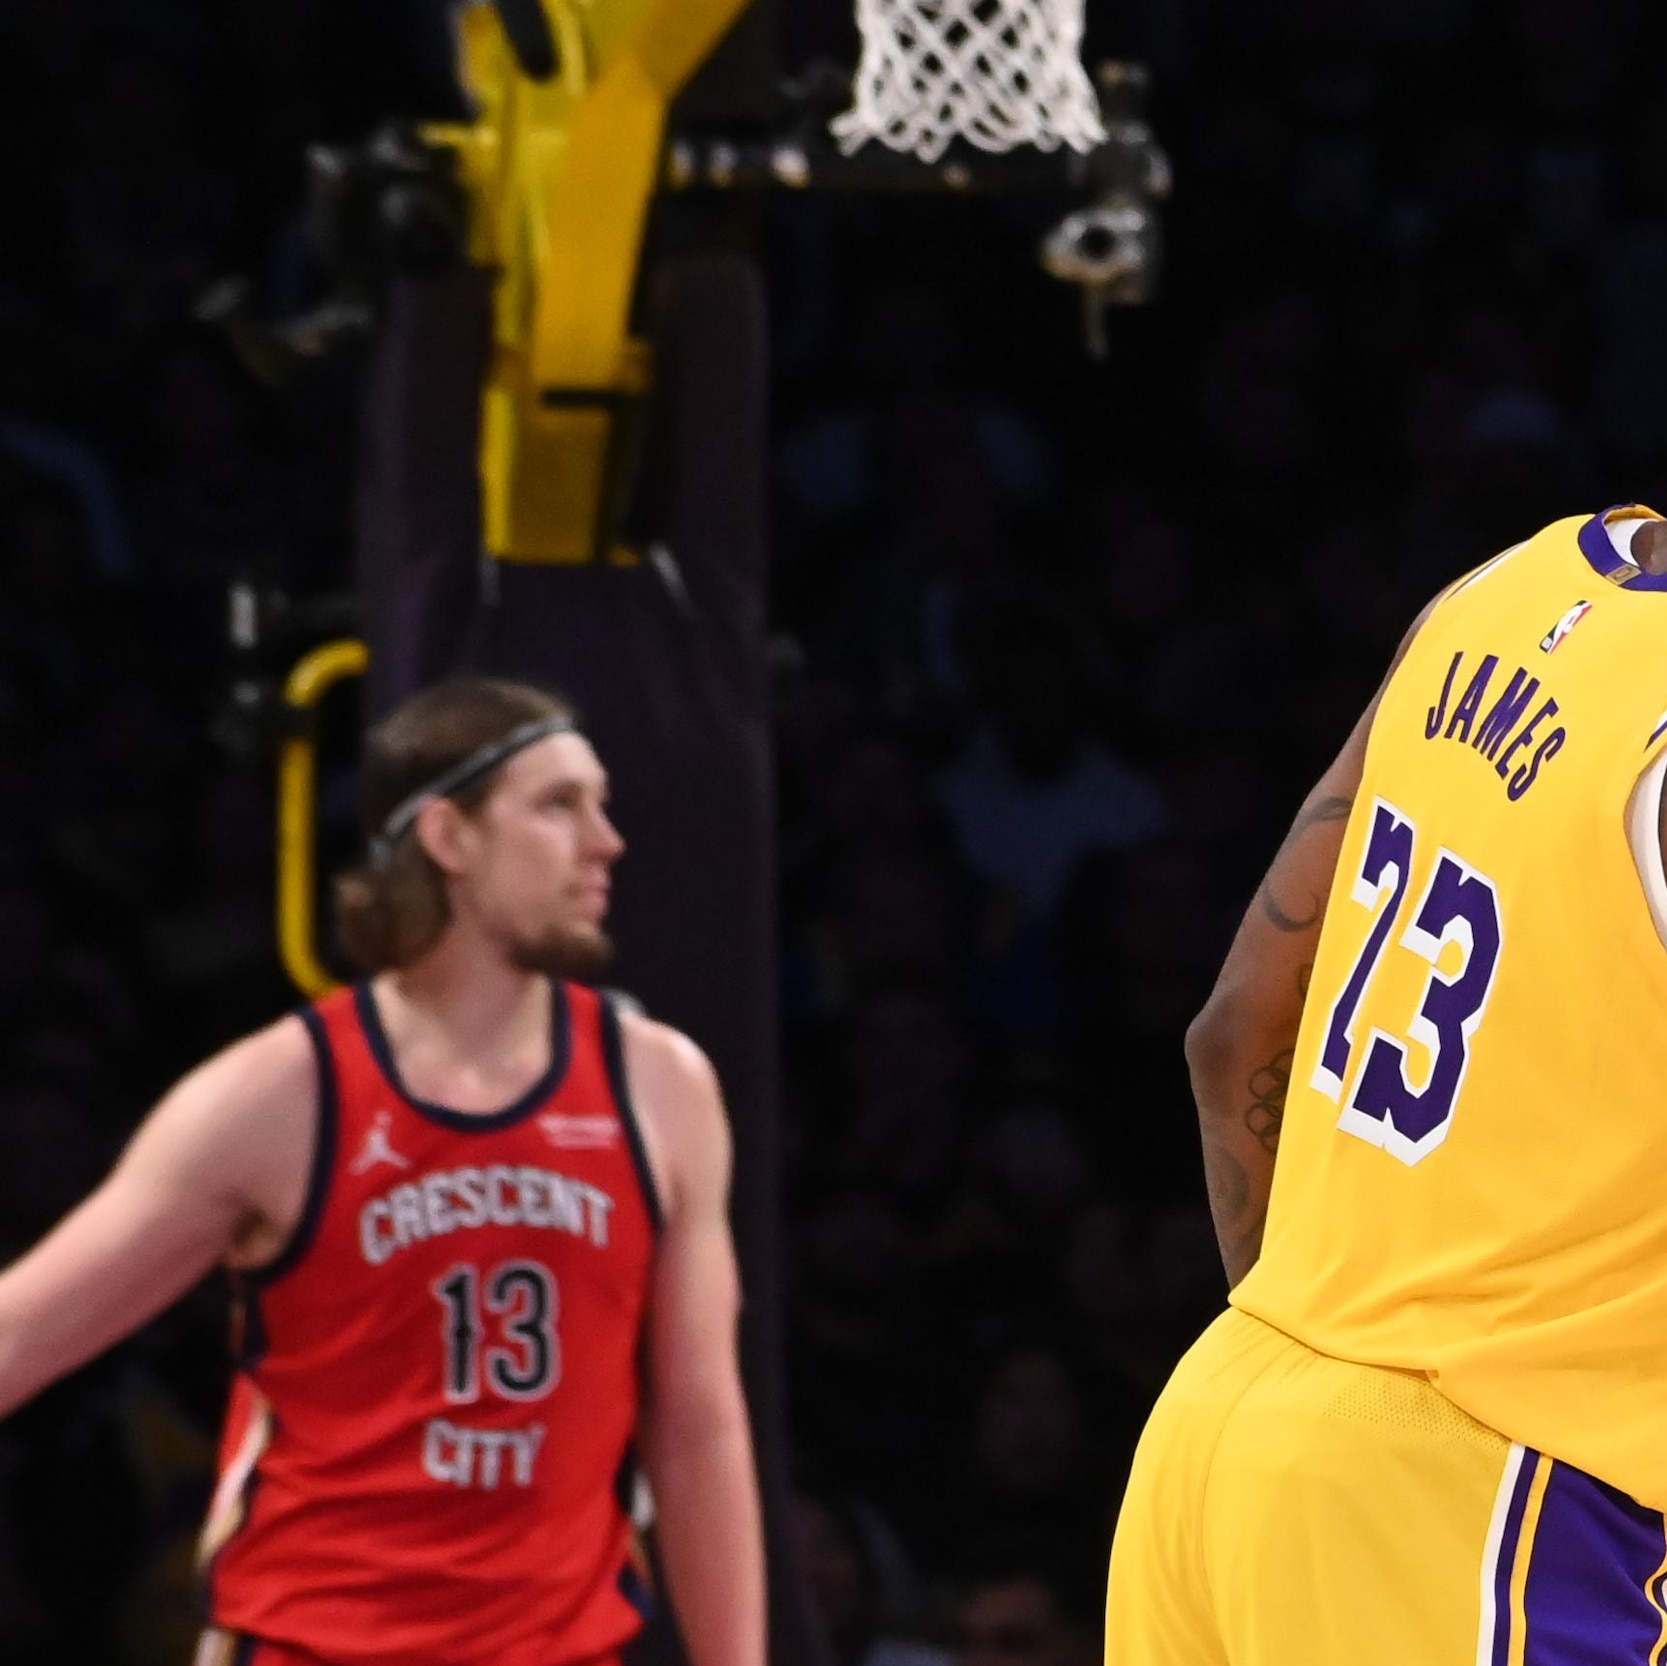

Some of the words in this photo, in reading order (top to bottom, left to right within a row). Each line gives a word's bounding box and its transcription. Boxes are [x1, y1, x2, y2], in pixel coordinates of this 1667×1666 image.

[1425, 651, 1567, 802] JAMES
[359, 1164, 614, 1266] CRESCENT
[430, 1259, 562, 1404] 13
[423, 1417, 548, 1491] CITY
